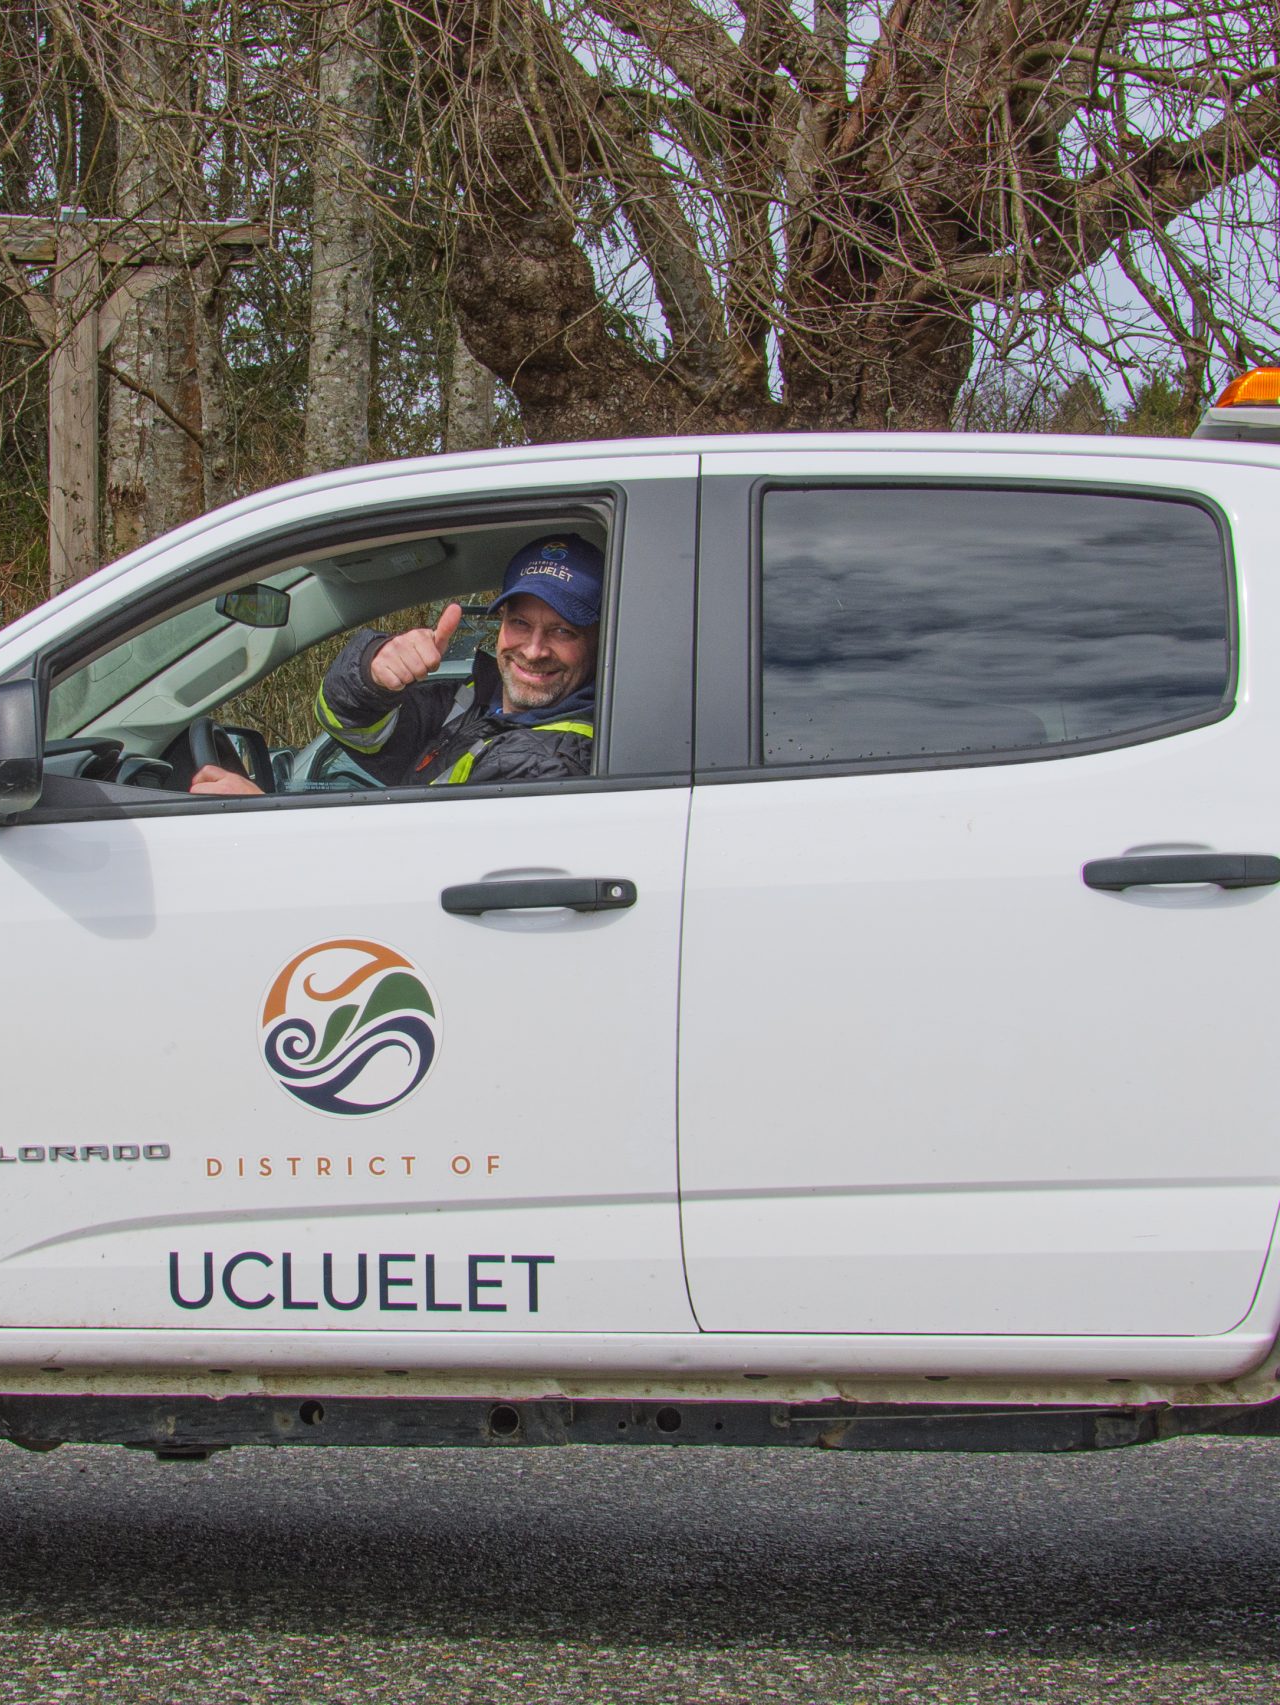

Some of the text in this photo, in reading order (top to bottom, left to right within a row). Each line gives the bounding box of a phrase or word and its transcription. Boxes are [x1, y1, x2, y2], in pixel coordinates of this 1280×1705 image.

[520, 566, 573, 582] UCLUELET
[207, 1154, 501, 1178] DISTRICT OF
[169, 1251, 555, 1313] UCLUELET
